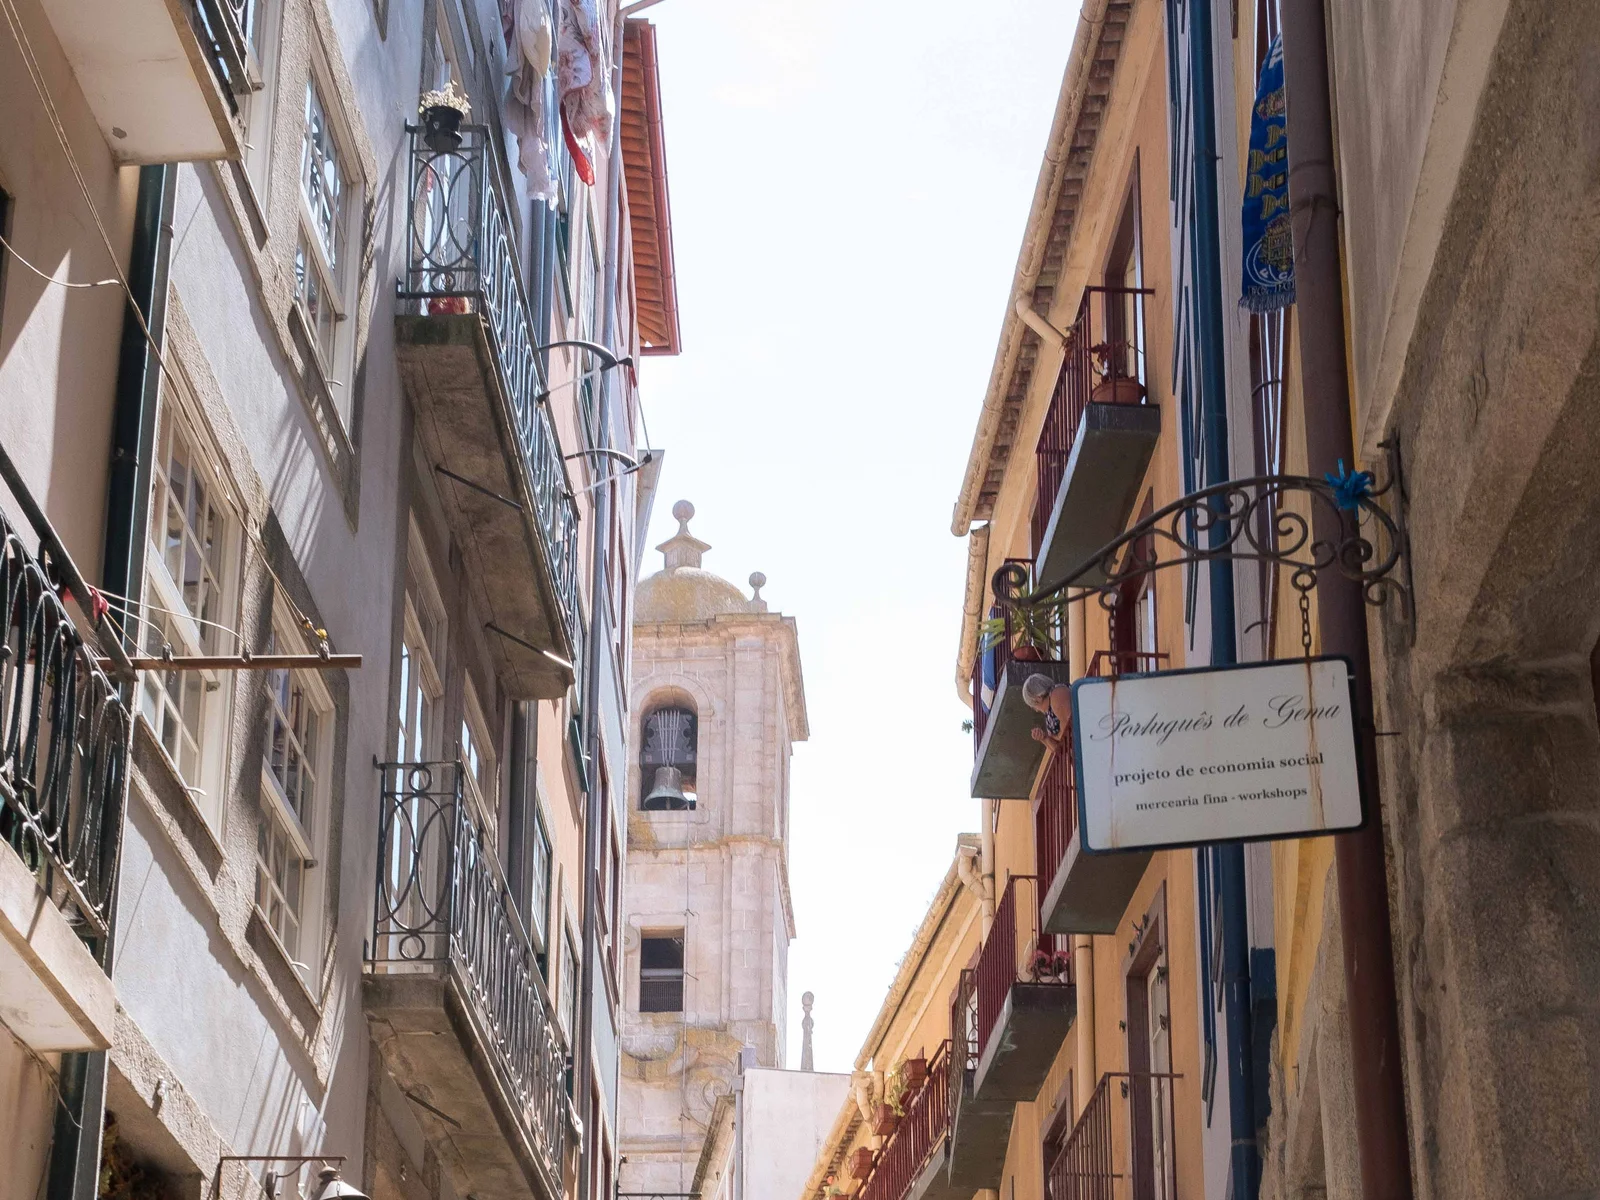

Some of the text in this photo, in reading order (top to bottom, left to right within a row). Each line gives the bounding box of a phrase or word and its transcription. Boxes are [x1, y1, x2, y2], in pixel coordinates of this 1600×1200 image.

[1090, 694, 1342, 747] Português de Gema
[1114, 752, 1325, 787] projeto de economia social
[1135, 794, 1199, 811] mercearia
[1203, 792, 1228, 806] fina
[1237, 786, 1308, 803] workshops
